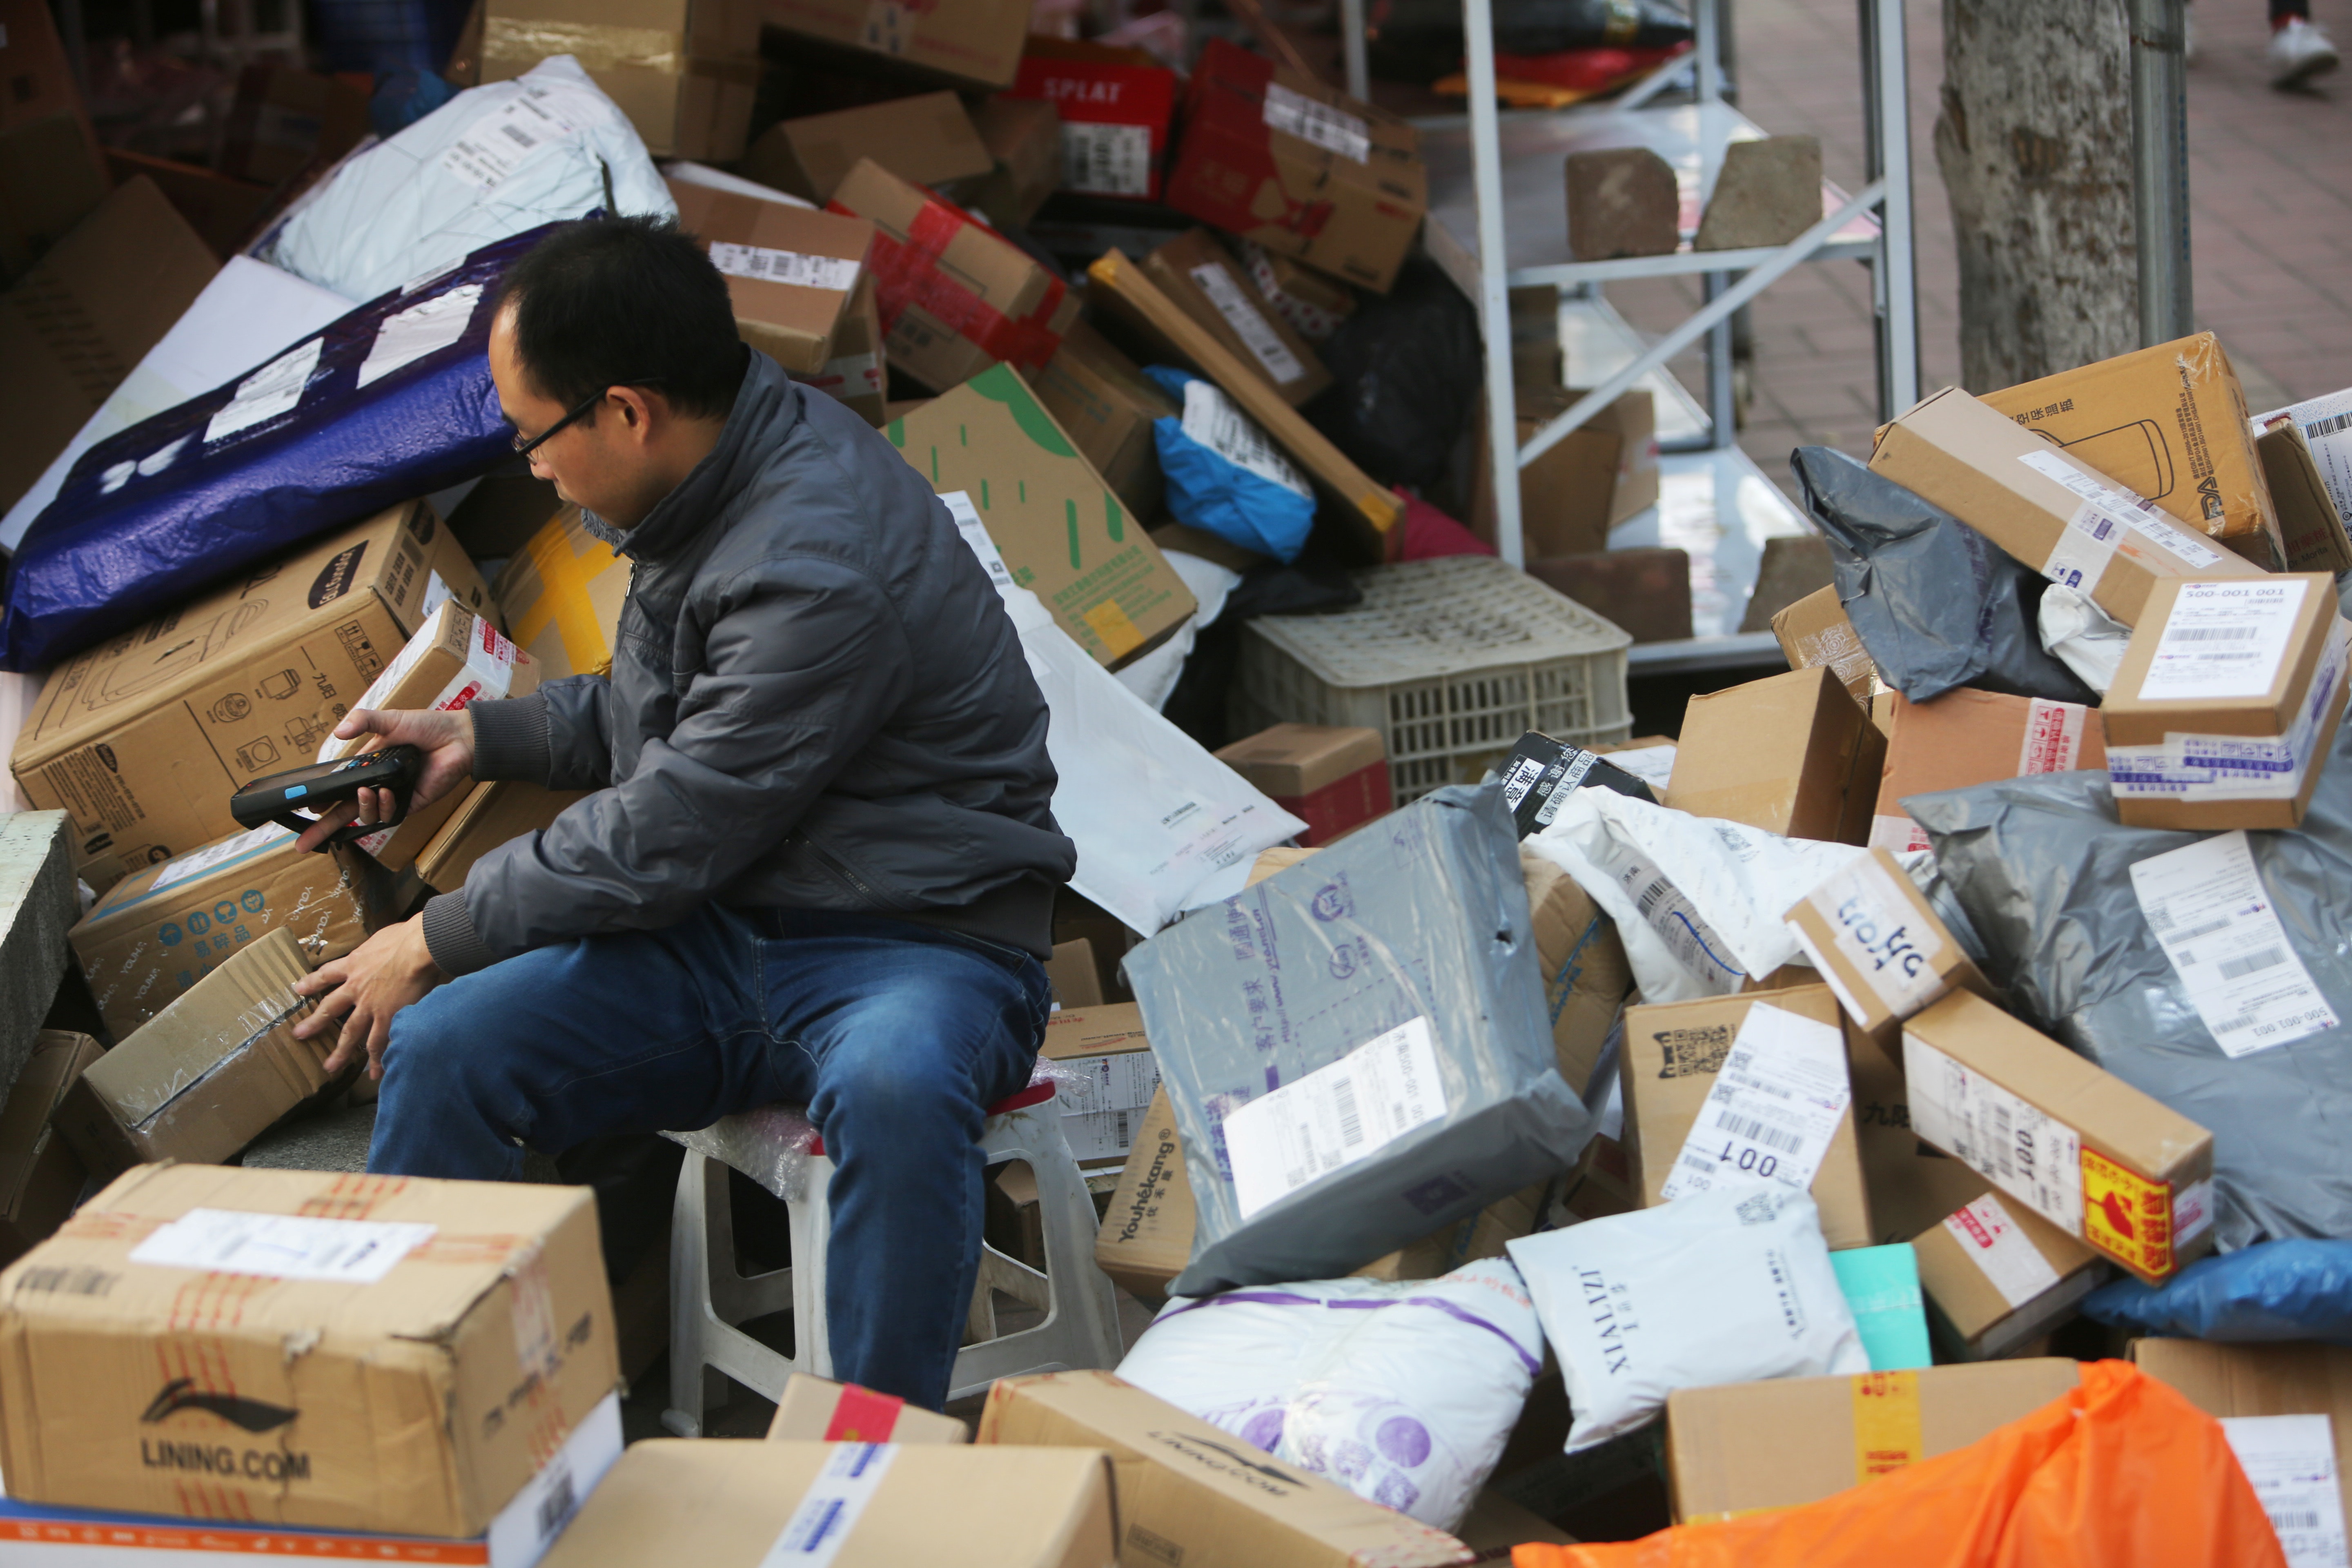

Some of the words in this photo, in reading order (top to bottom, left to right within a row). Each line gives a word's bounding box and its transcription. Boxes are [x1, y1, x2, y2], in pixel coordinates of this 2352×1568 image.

[1043, 78, 1123, 104] SPLAT
[2009, 399, 2074, 425] 空保温瓶
[2185, 590, 2250, 598] 500-001
[312, 673, 337, 699] 九阳
[1506, 766, 1539, 804] 满意
[1537, 747, 1578, 797] 感谢您
[1541, 753, 1595, 818] 请确认商品
[194, 924, 251, 958] 易碎品
[1720, 1141, 1777, 1177] 001
[2016, 1129, 2036, 1180] 001
[1579, 1269, 1632, 1375] XIALIZI
[140, 1438, 311, 1480] LINING.COM
[1146, 1430, 1289, 1498] LINING.COM
